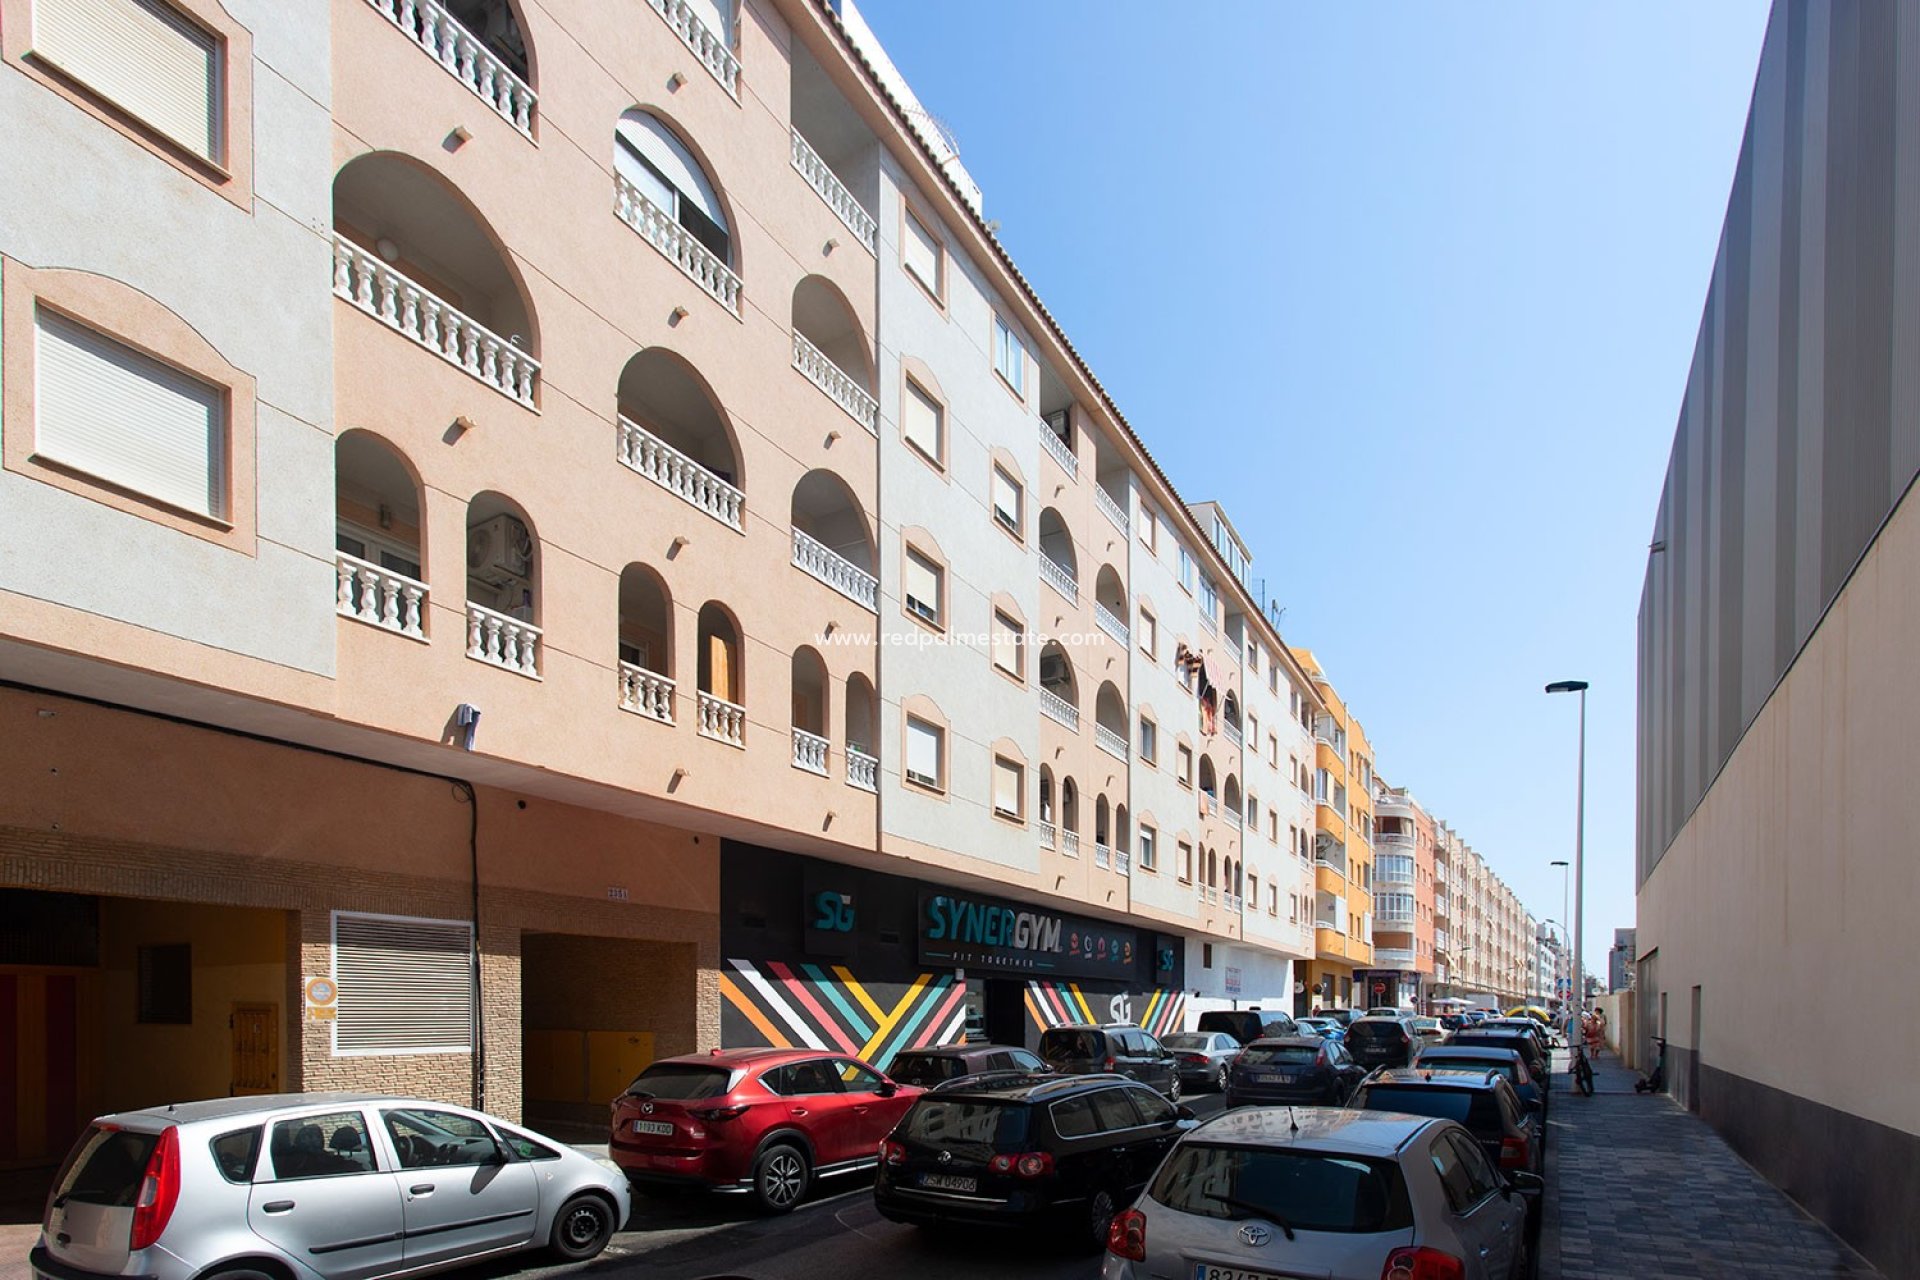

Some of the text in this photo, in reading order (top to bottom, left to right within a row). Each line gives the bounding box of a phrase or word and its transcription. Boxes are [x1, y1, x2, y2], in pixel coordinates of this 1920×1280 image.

[928, 896, 1063, 953] SYNERGYM
[952, 952, 1034, 968] FIT TOGETHER
